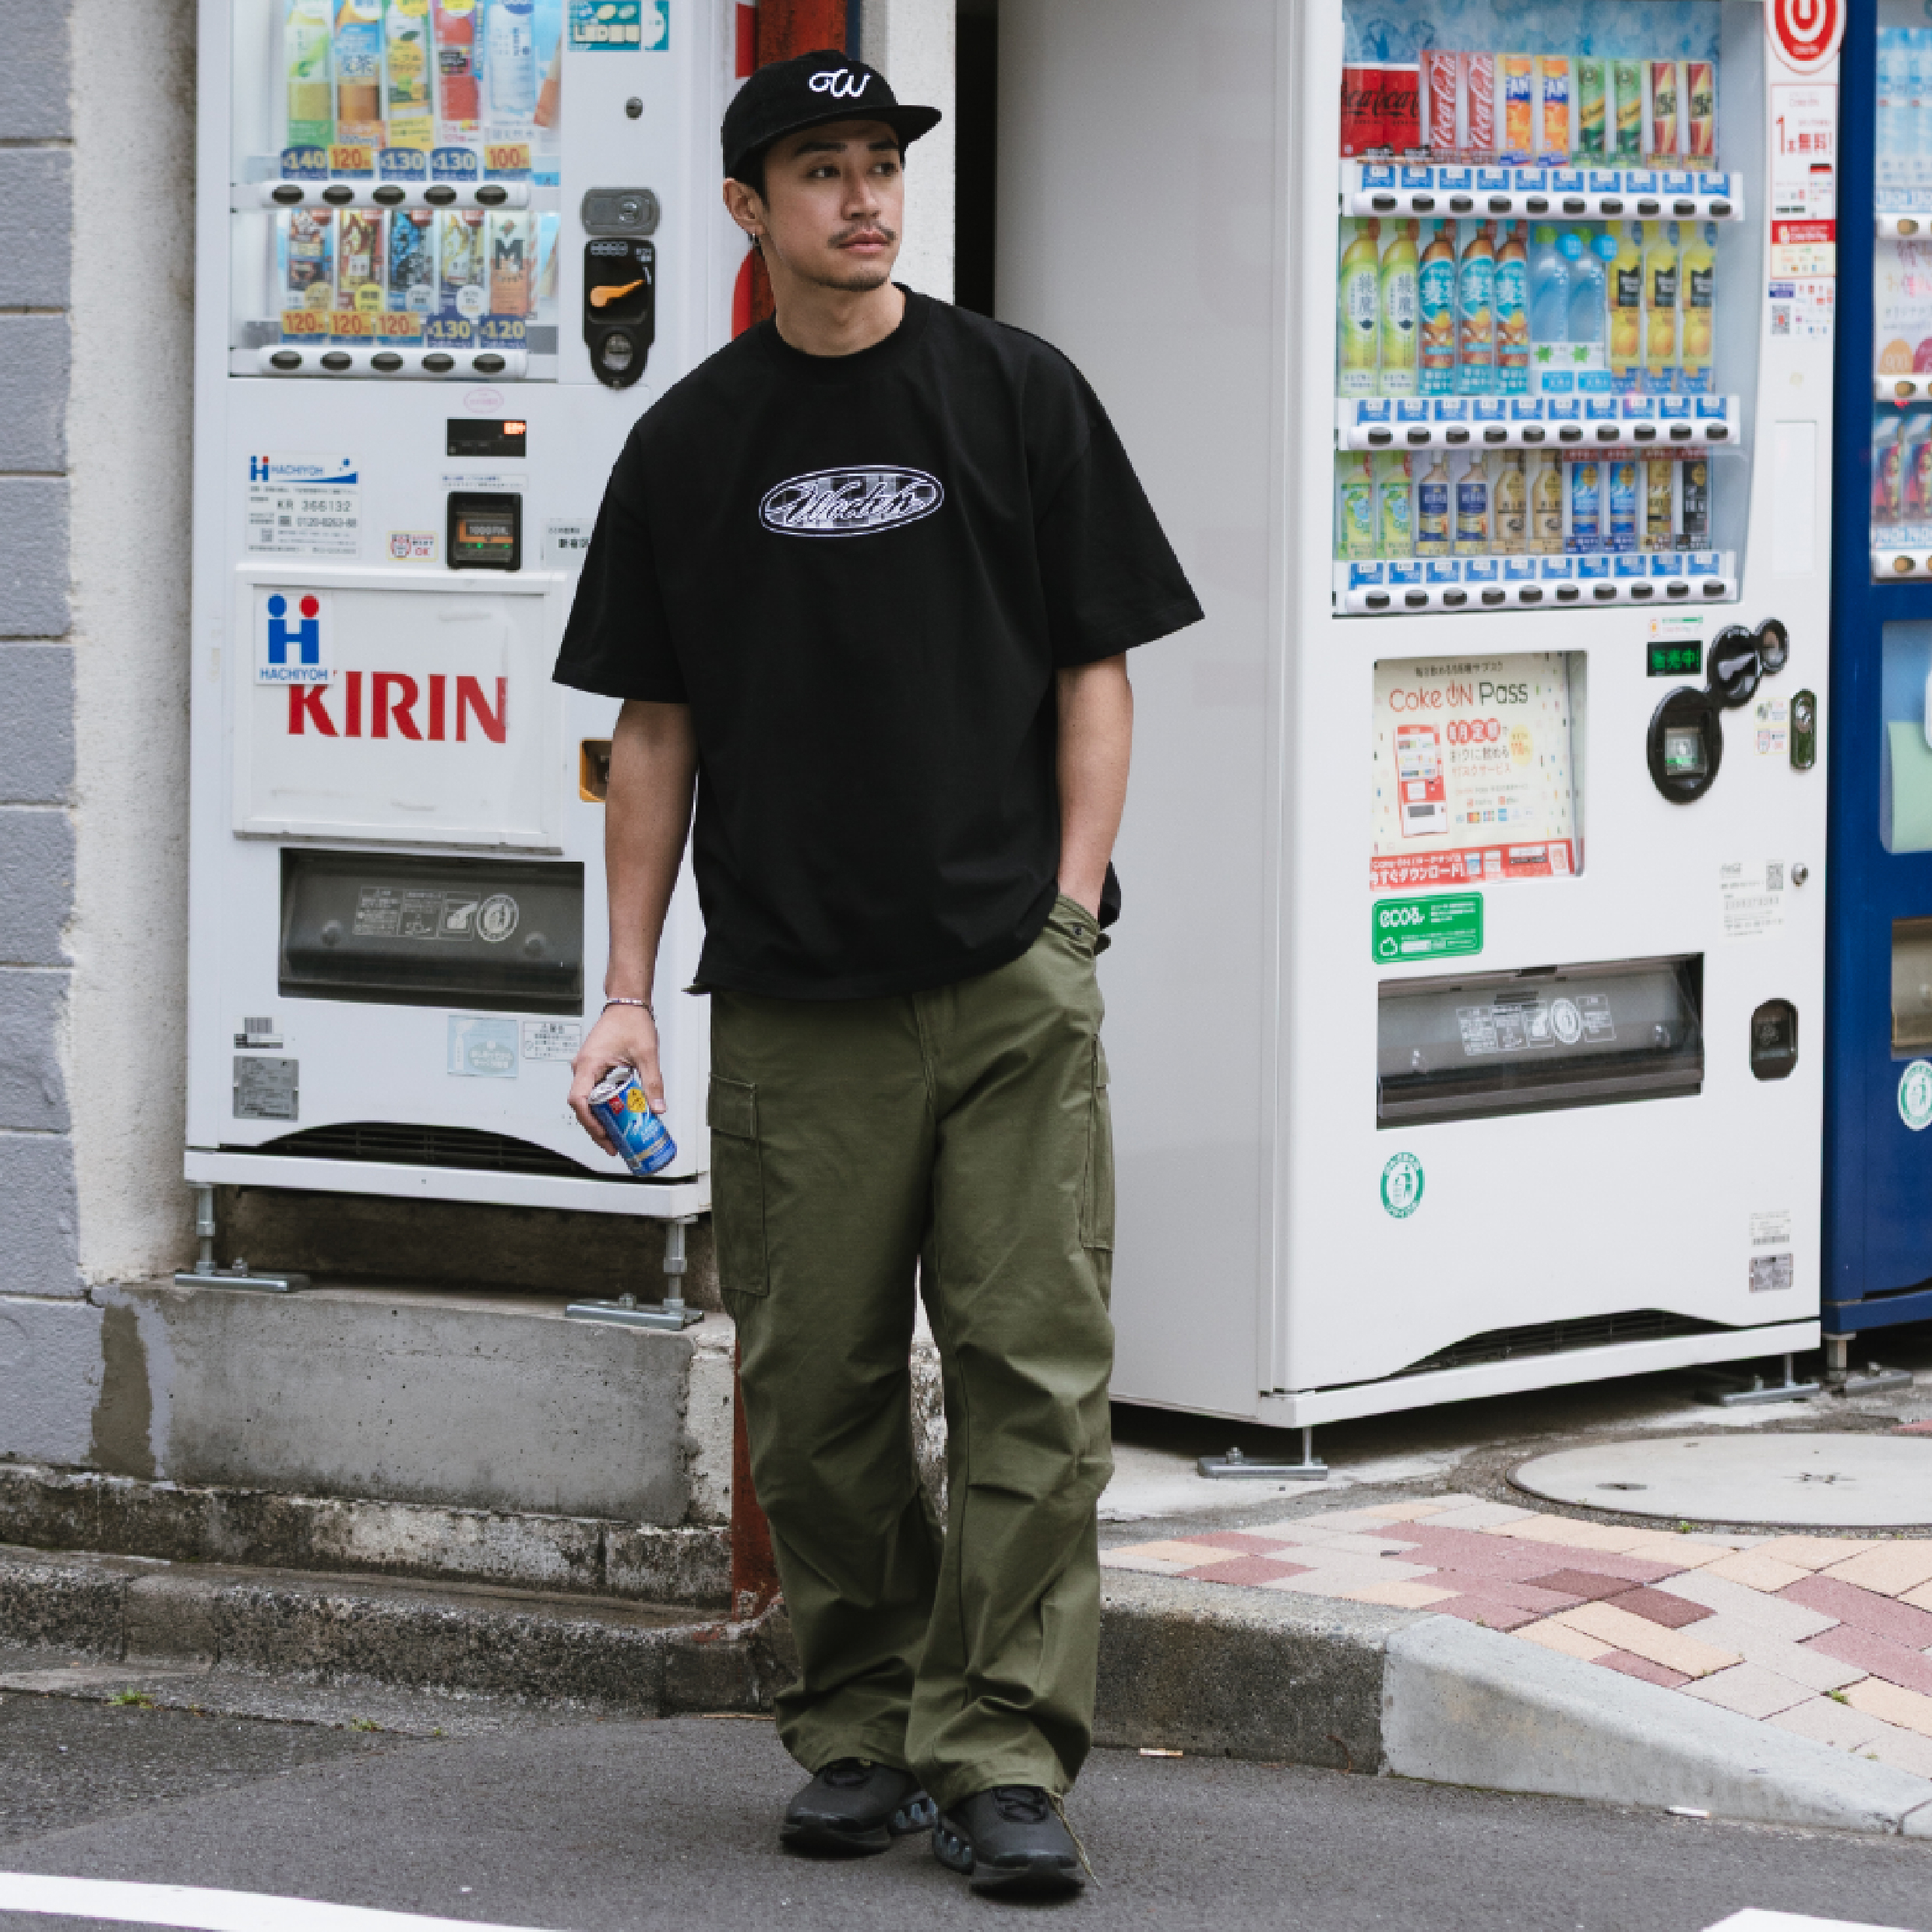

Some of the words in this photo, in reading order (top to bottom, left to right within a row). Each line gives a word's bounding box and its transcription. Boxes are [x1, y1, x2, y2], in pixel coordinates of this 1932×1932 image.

[271, 465, 324, 476] HACHIYOH
[260, 668, 329, 681] HACHIYOH
[1389, 686, 1444, 712] Coke
[1446, 679, 1474, 707] ON
[1479, 682, 1528, 706] Pass
[287, 670, 509, 745] KIRIN
